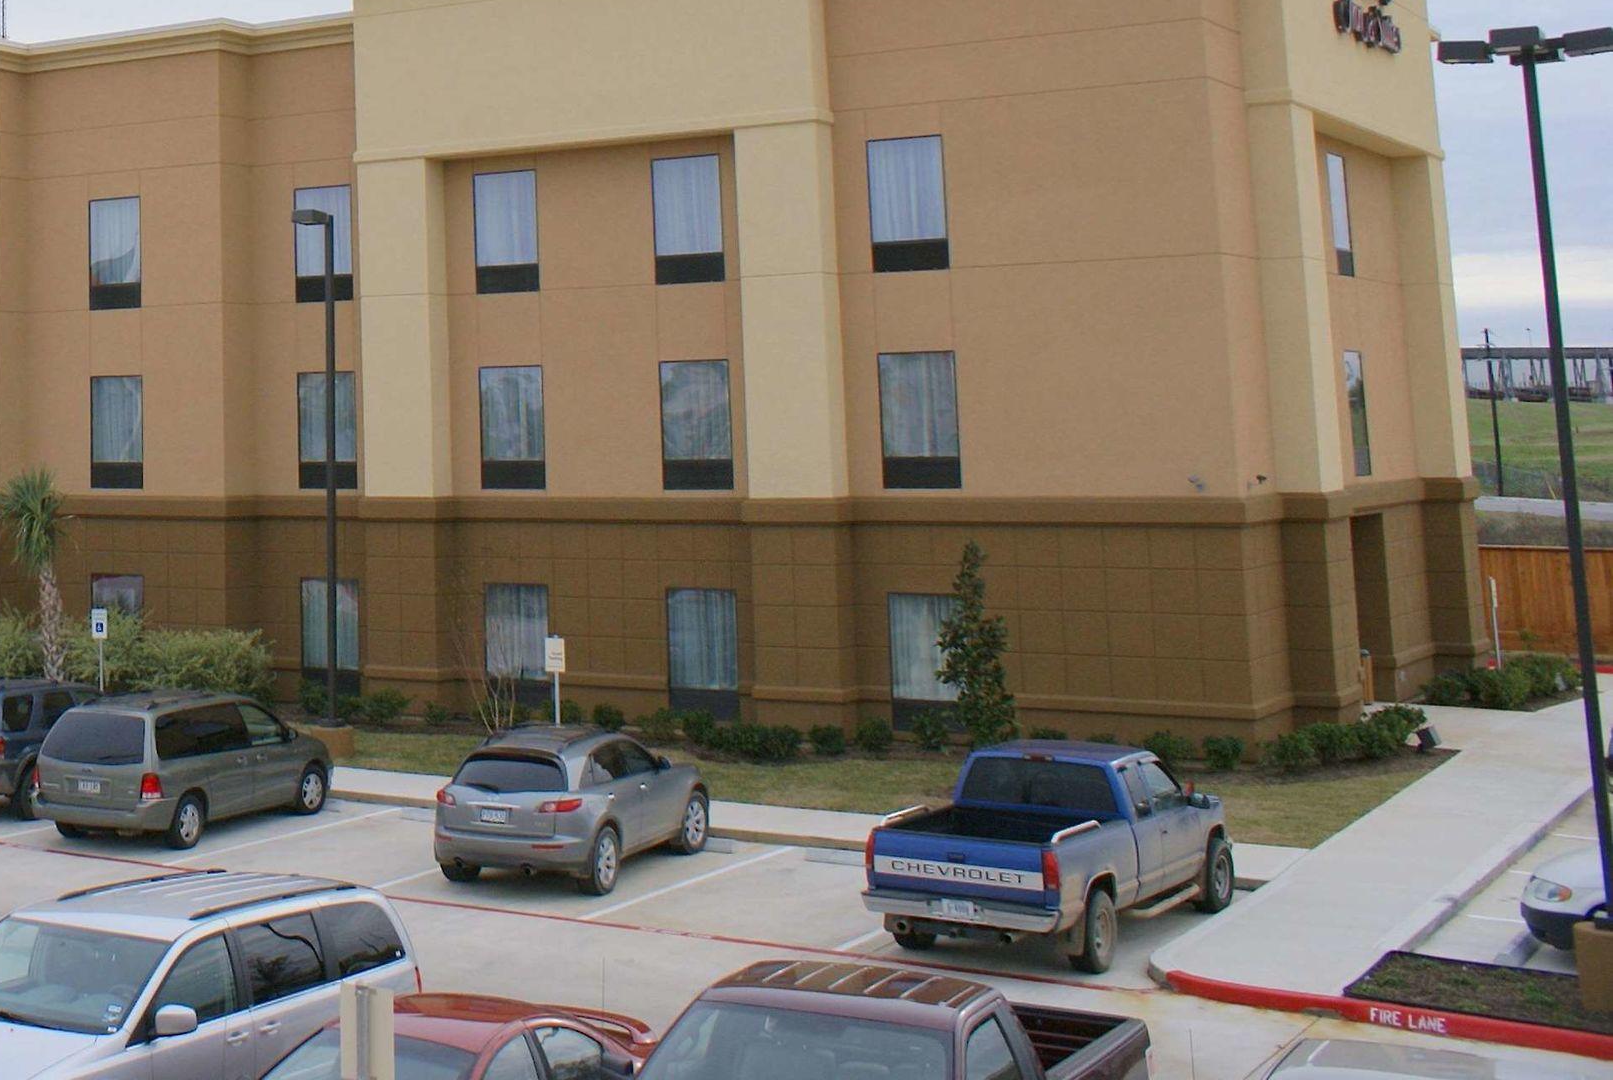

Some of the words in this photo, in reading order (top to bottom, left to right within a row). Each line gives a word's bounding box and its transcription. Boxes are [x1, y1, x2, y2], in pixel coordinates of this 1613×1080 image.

[891, 859, 1025, 885] CHEVROLET
[1369, 1006, 1402, 1028] FIRE
[1408, 1013, 1448, 1034] LANE
